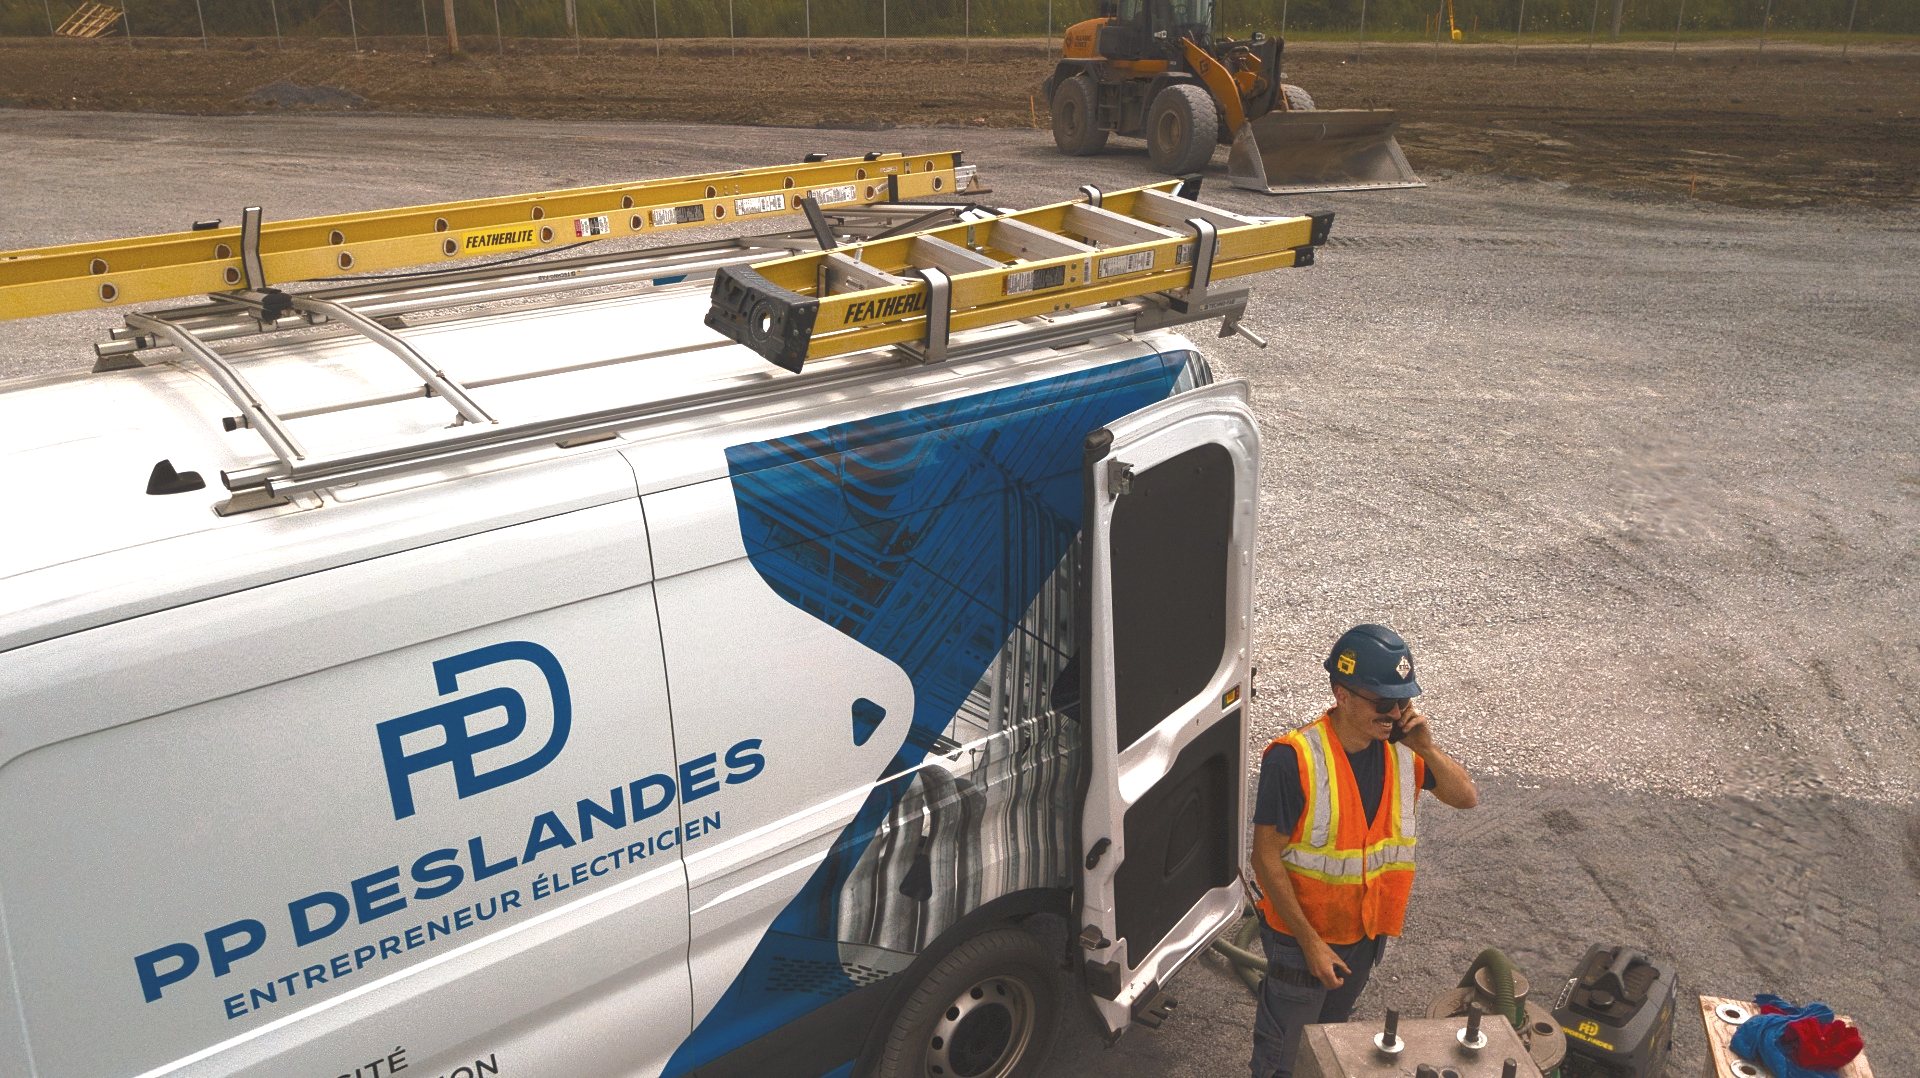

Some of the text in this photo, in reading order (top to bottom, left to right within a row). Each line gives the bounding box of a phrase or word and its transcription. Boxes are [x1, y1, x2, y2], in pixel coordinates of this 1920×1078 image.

[465, 229, 534, 249] FEATHERLITE
[843, 291, 928, 324] FEATHERLI
[135, 738, 765, 1003] PP DESLANDES
[223, 811, 721, 1019] ENTREPRENEUR ÉLECTRICIEN
[439, 1053, 499, 1078] ON
